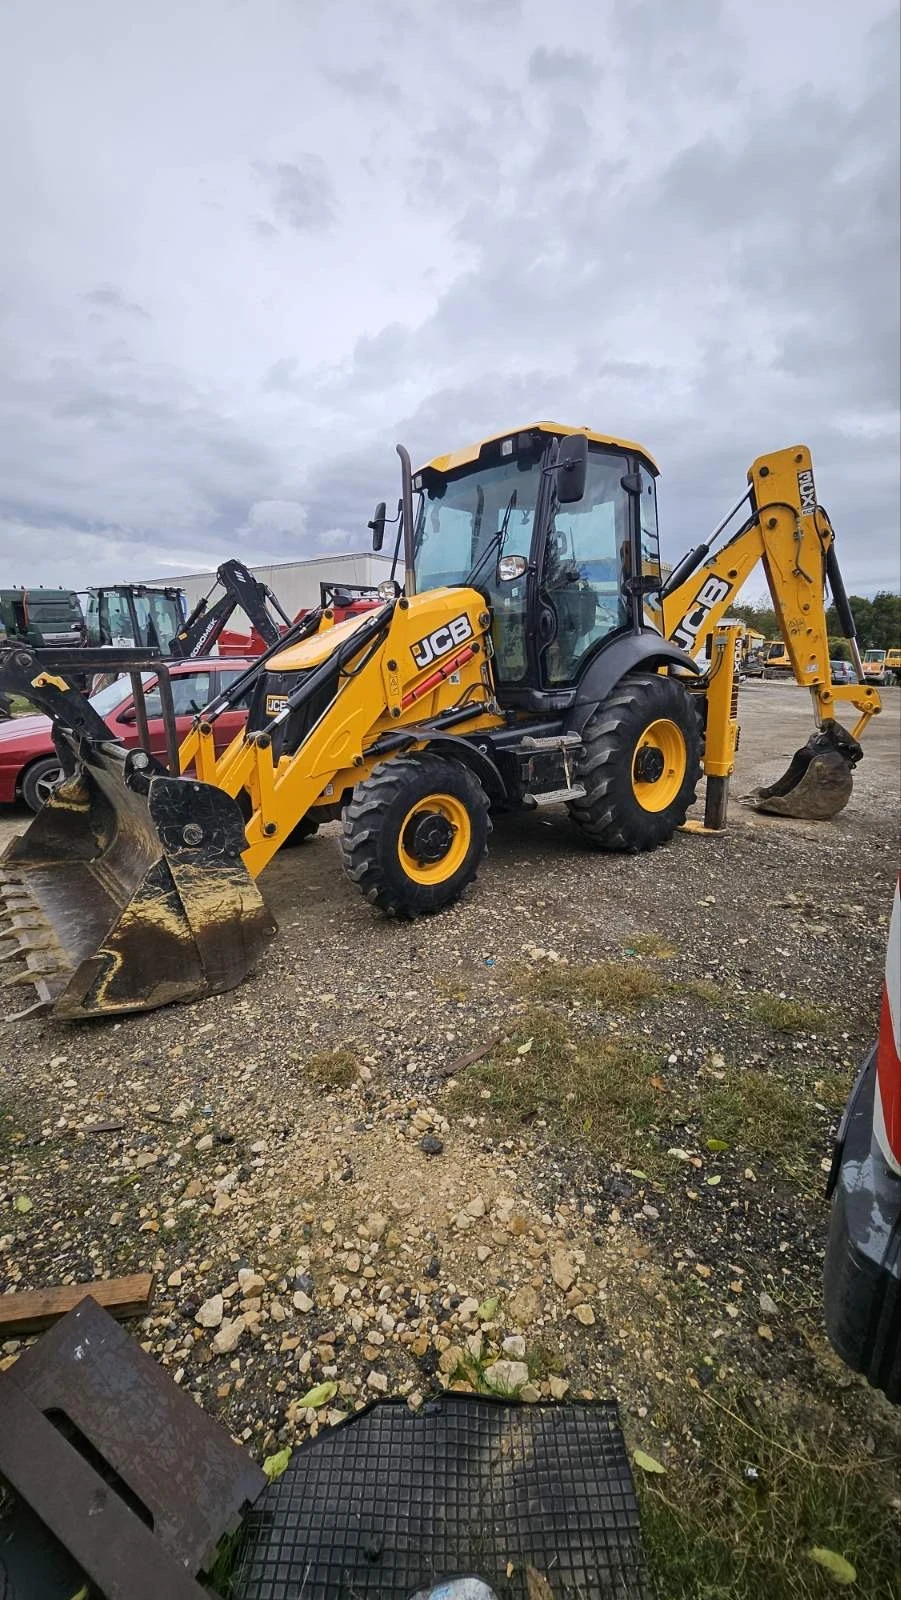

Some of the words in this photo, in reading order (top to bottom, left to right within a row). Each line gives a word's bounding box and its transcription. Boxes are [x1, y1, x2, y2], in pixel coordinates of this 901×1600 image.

[798, 471, 815, 507] 3CX
[671, 577, 729, 651] JCB
[415, 616, 472, 667] JCB
